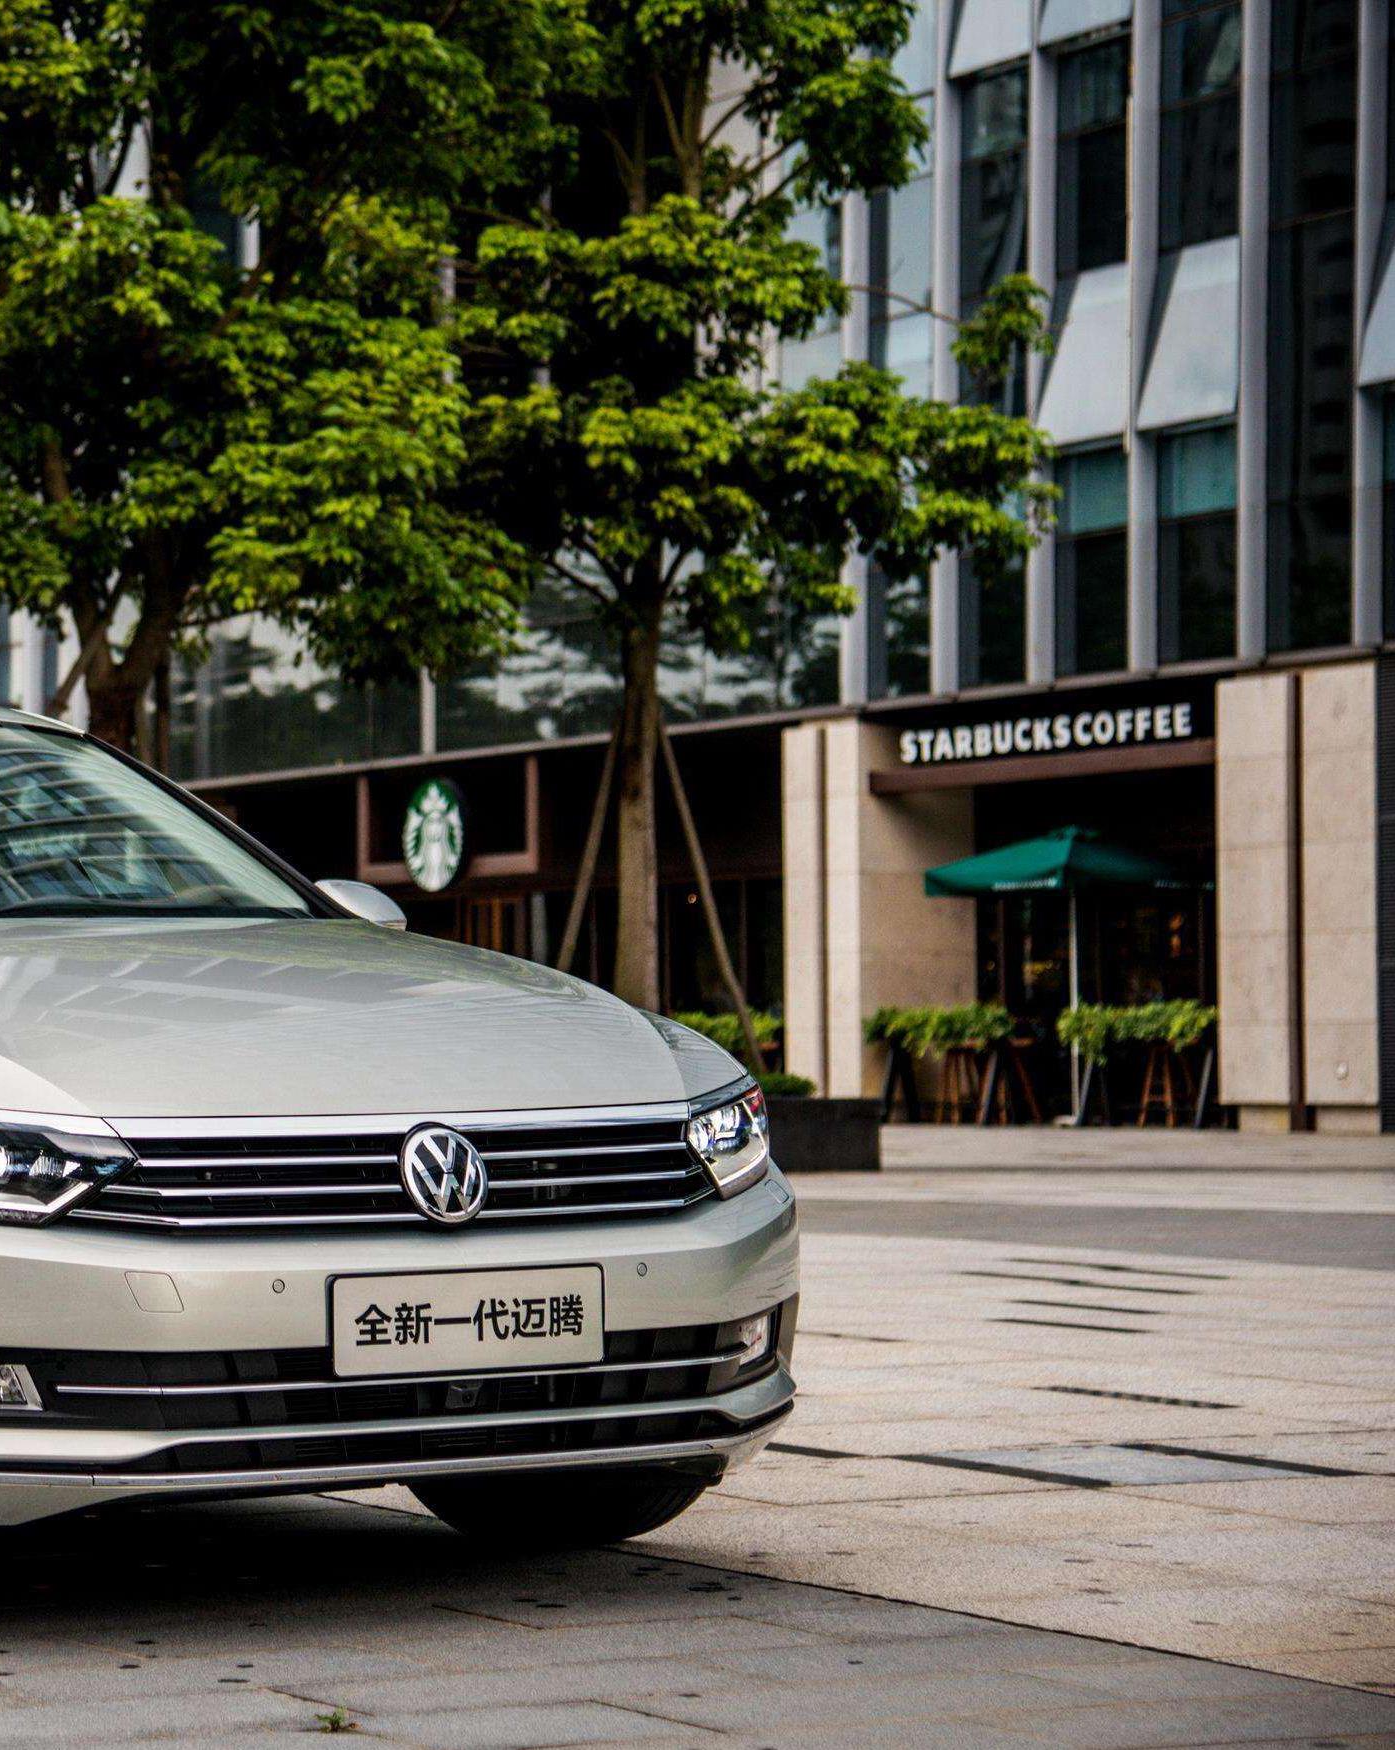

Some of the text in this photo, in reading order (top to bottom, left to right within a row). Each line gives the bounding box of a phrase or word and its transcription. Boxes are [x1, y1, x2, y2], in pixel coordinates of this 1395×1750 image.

[354, 1293, 584, 1347] 全新一代迈腾
